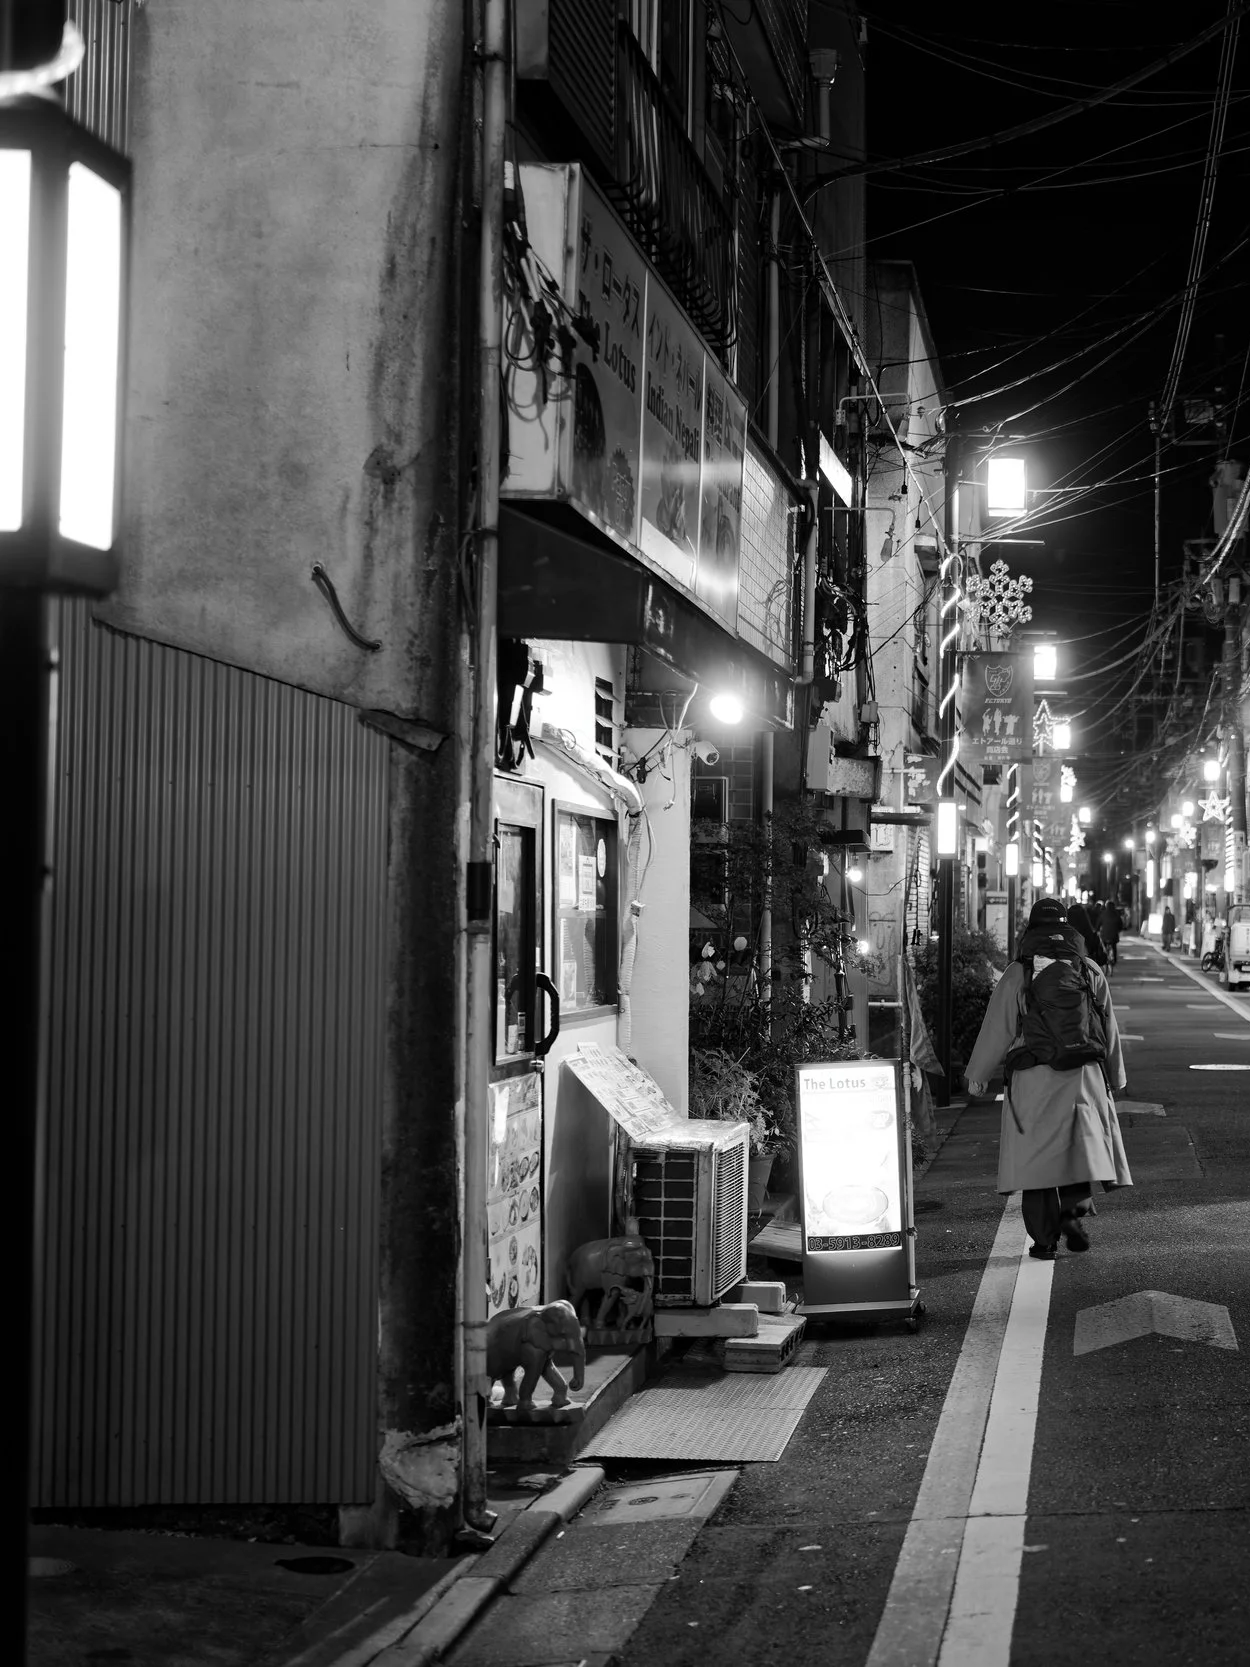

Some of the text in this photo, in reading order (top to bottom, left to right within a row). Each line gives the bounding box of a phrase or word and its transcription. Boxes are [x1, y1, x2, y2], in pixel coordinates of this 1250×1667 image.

[604, 321, 636, 394] Lotus
[647, 371, 700, 464] Indian Nepali
[803, 1077, 866, 1090] The Lotus
[808, 1233, 900, 1252] 03-5913-8289
